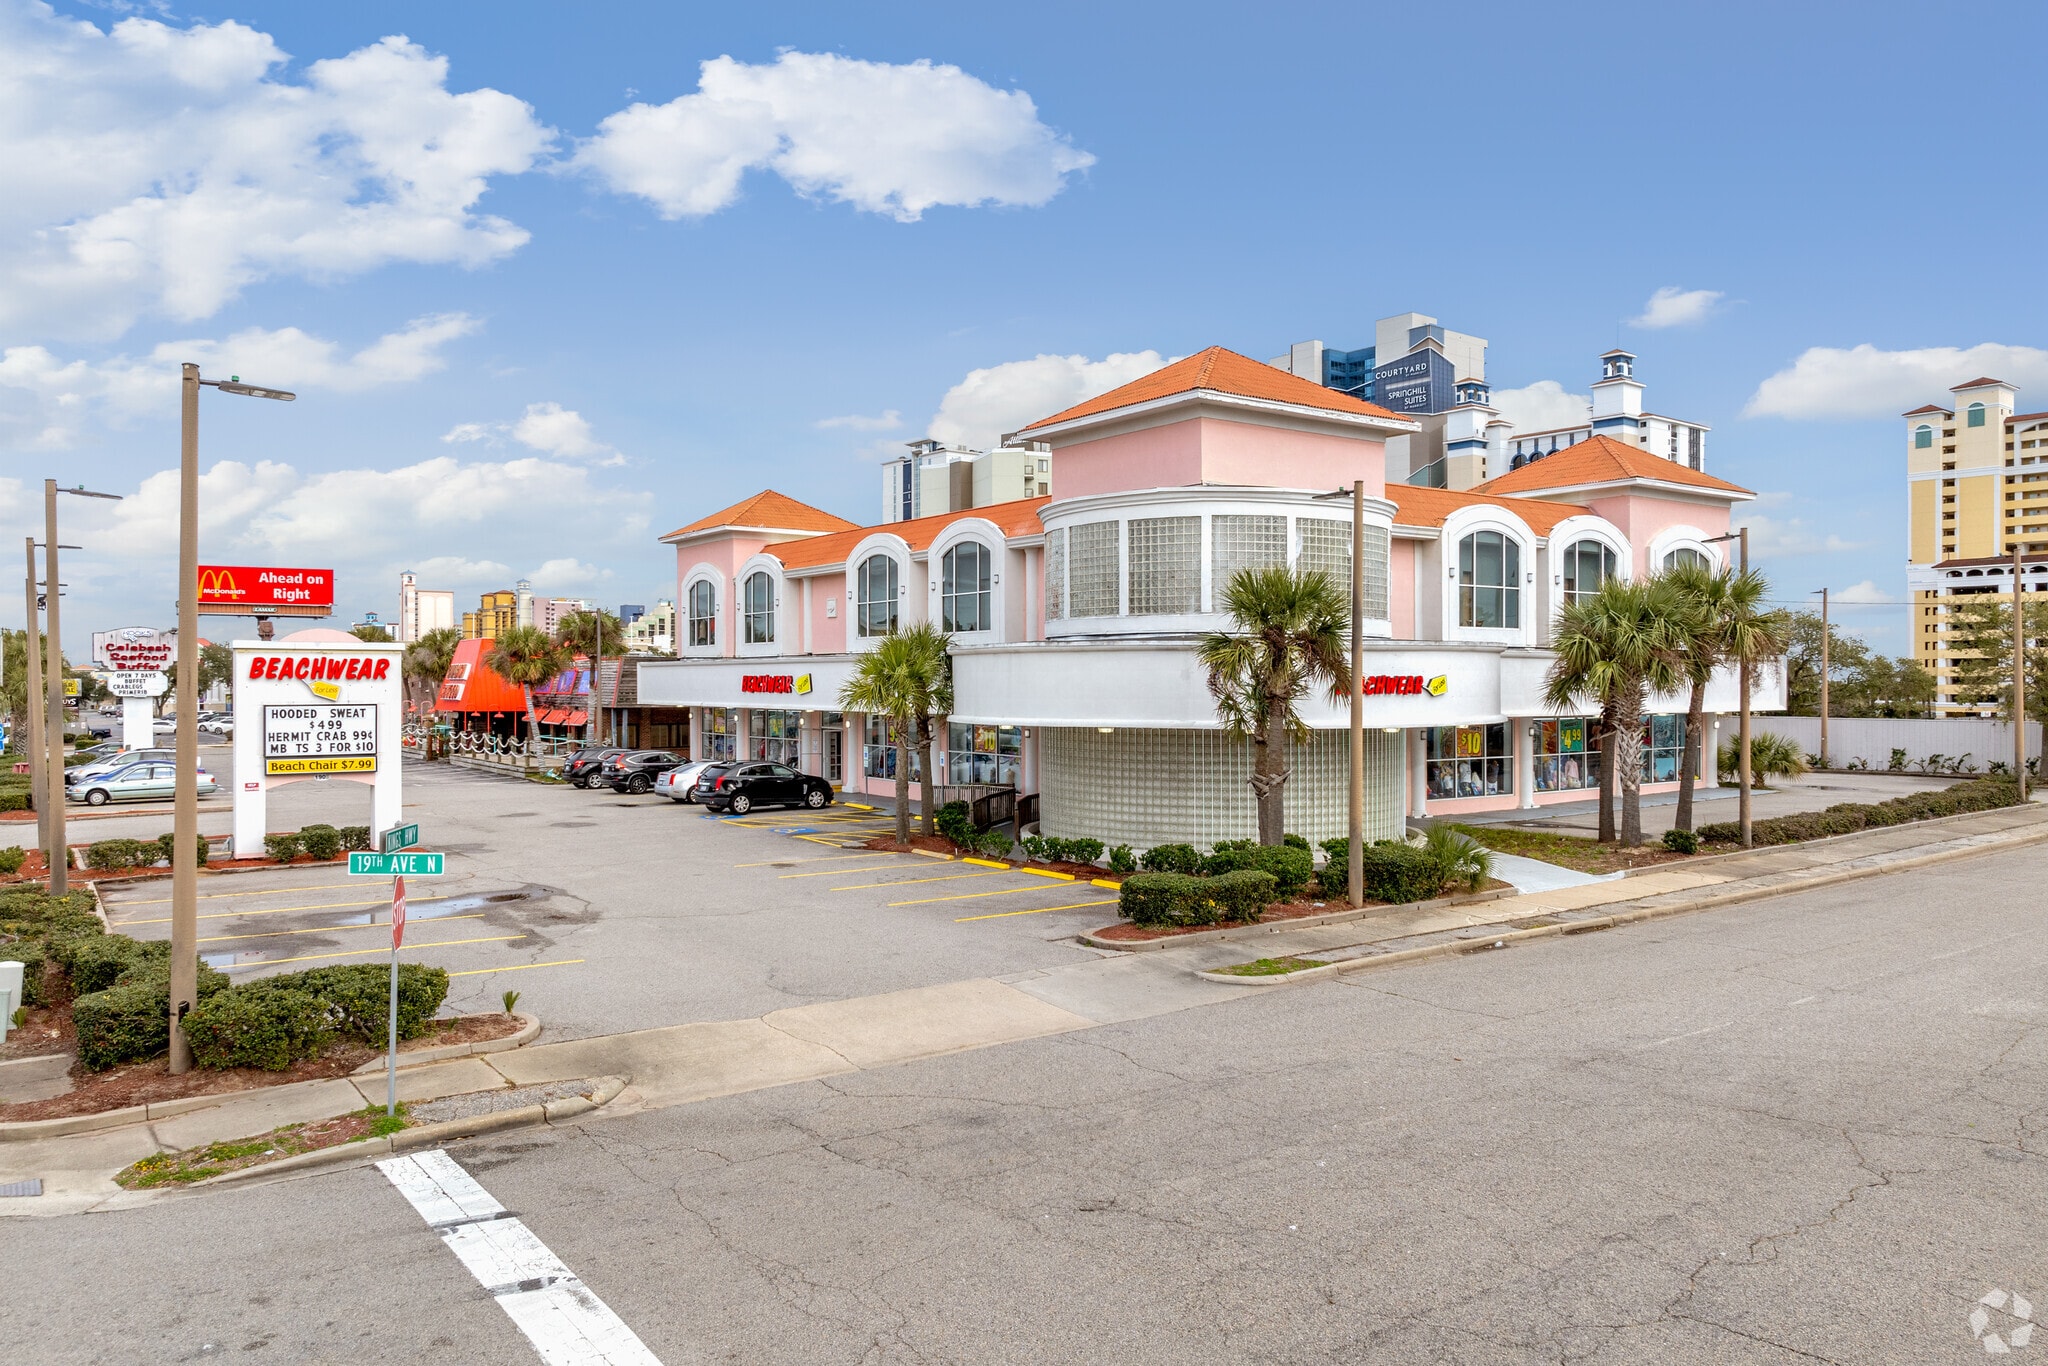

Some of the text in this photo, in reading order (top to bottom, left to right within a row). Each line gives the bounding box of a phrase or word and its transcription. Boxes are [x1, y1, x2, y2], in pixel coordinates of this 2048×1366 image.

[1375, 362, 1427, 380] COURTYARD
[1388, 386, 1426, 400] SPRINGHILL
[1404, 394, 1426, 405] SUITES
[258, 572, 324, 584] Ahead on
[273, 588, 310, 602] Right
[106, 643, 172, 652] Calabash
[110, 652, 168, 661] Seafood
[116, 662, 160, 670] Buffet
[249, 656, 390, 680] BEACHWEAR
[742, 675, 793, 693] BEACHWEAR
[272, 708, 366, 719] HOODED SWEAT
[268, 730, 373, 742] HERMIT CRAB 99¢
[270, 742, 374, 754] MB TS 3 FOR $10
[1461, 732, 1480, 754] $10
[271, 760, 372, 772] Beach Chair $7.99
[404, 826, 417, 846] HWY
[357, 856, 436, 872] 19TH AVE N
[393, 896, 405, 930] STOP
